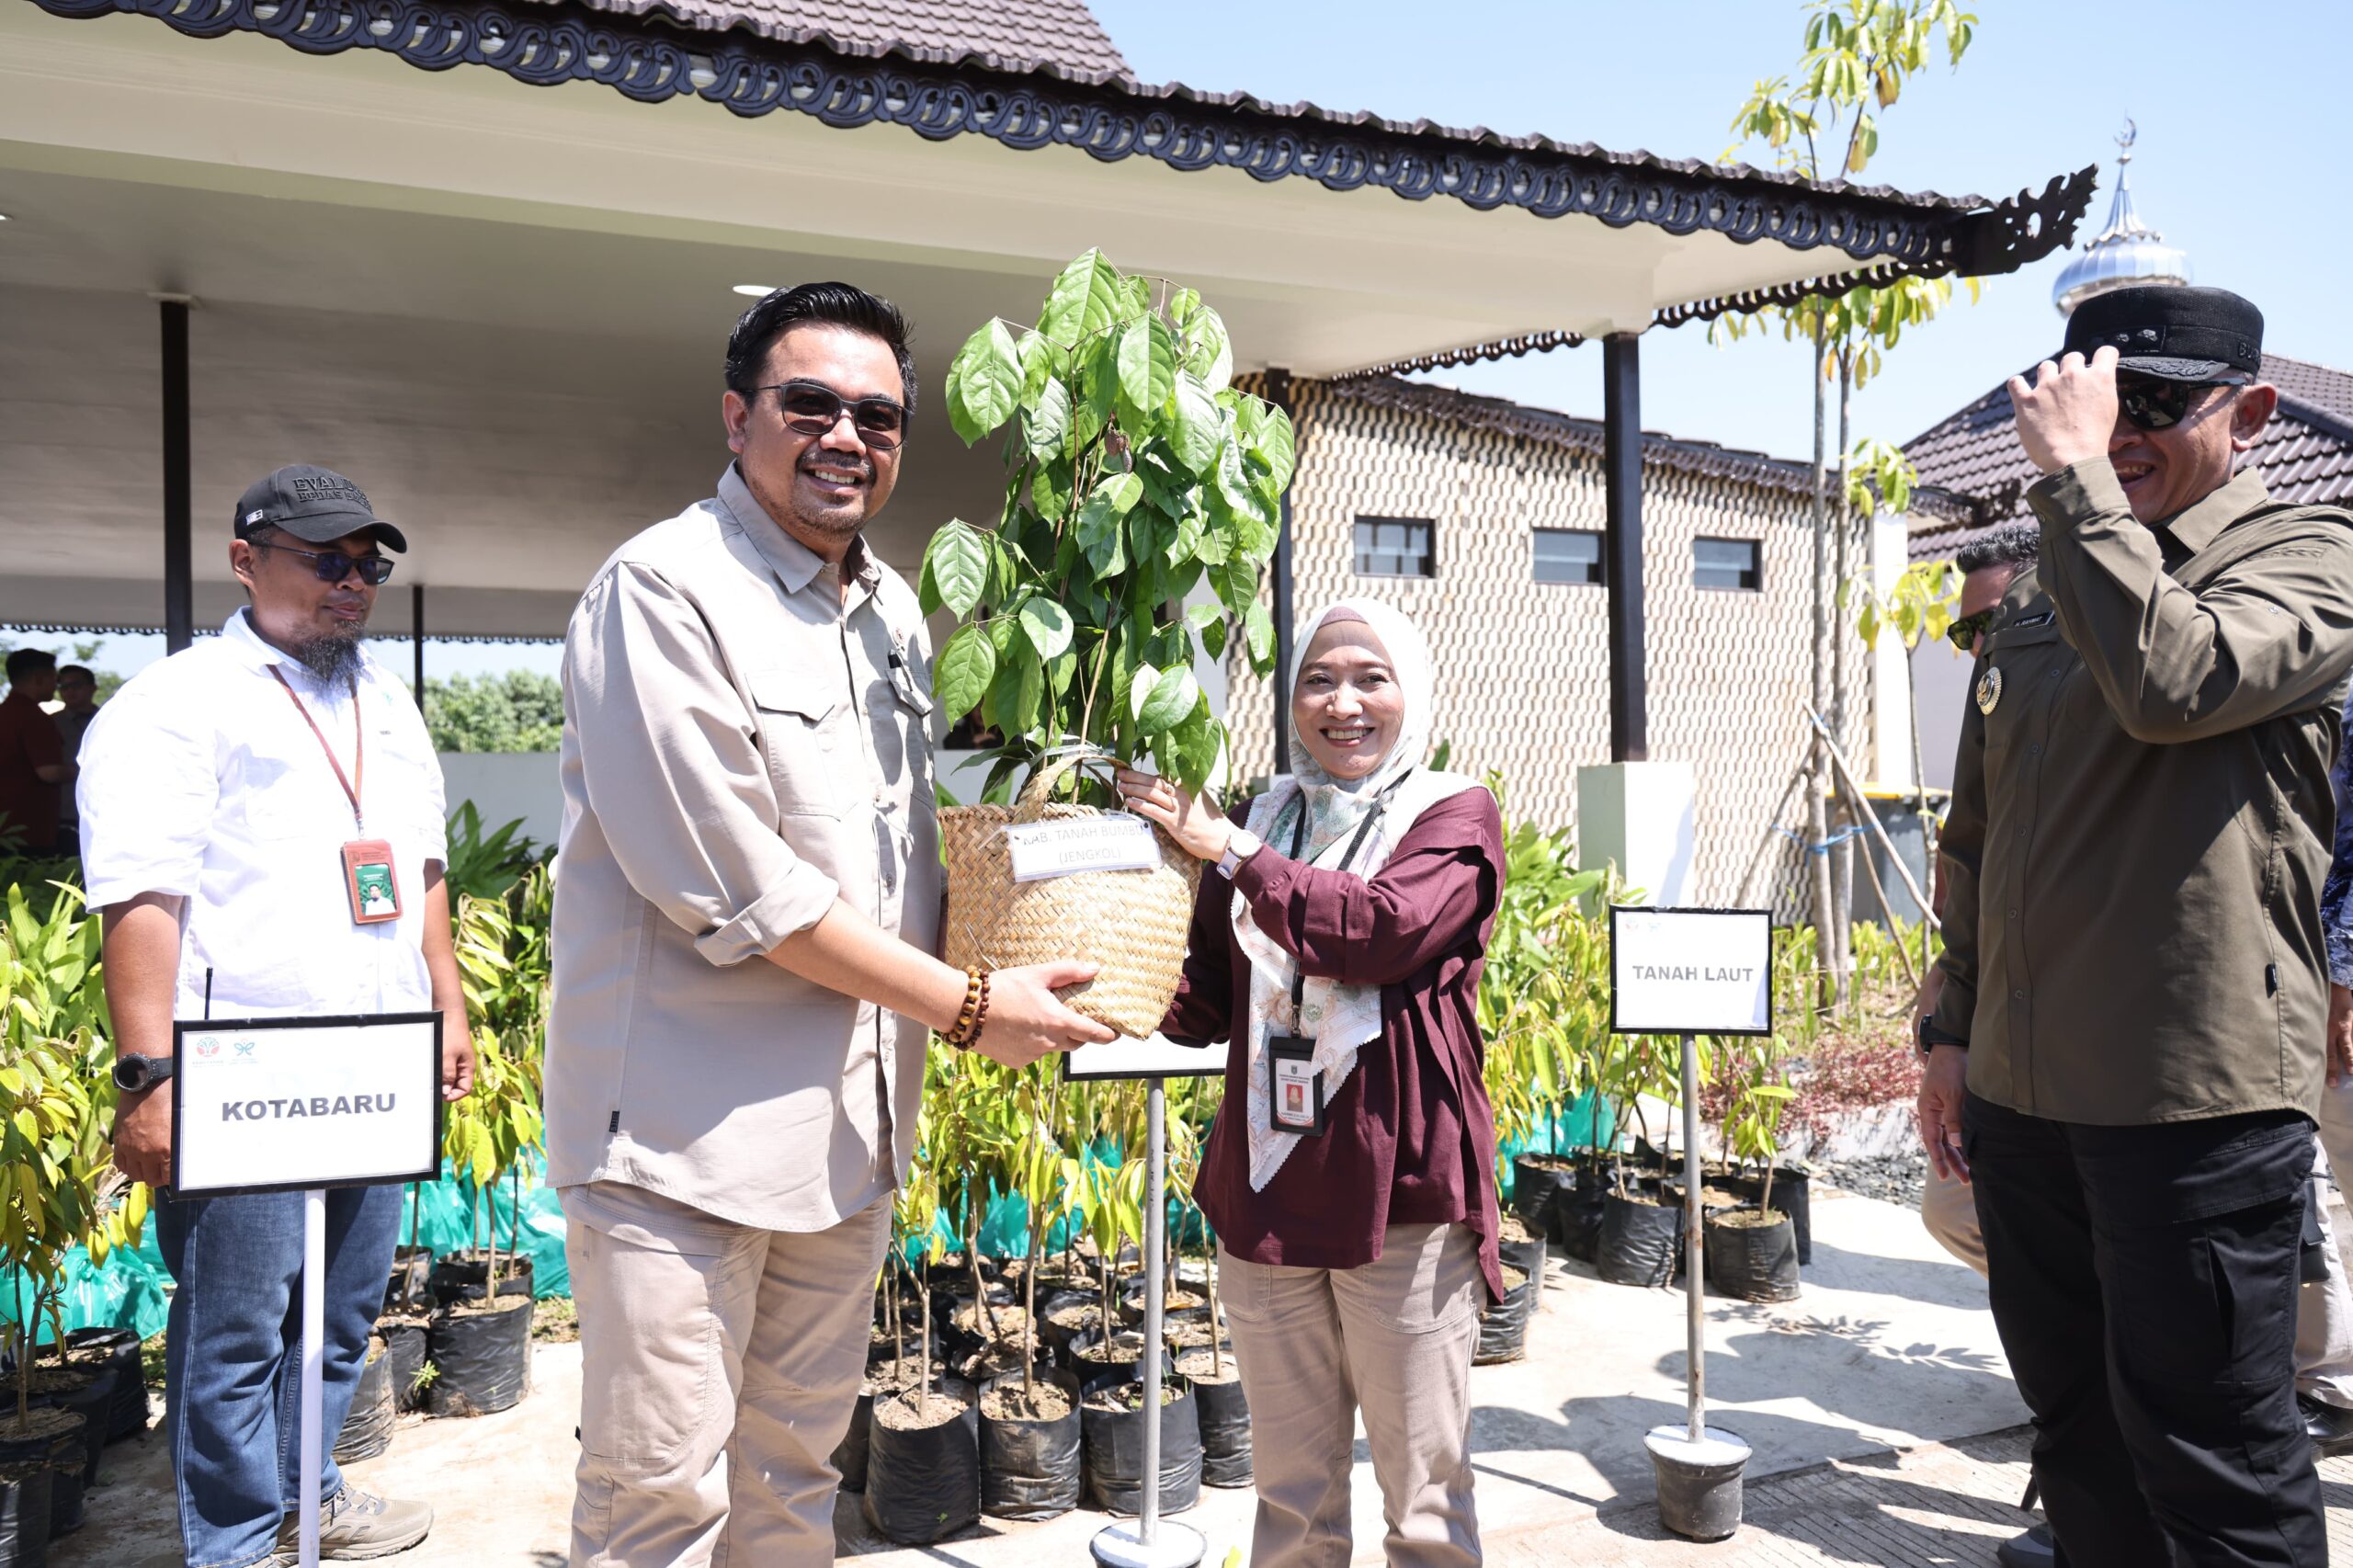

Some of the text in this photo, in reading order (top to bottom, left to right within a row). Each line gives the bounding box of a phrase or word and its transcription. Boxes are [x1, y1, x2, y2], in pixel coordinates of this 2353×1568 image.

[1055, 827, 1097, 841] TANAH
[1101, 824, 1144, 837] BUMBU
[1059, 847, 1121, 865] (JENGKOL)
[1632, 965, 1754, 982] TANAH LAUT
[222, 1093, 396, 1121] KOTABARU
